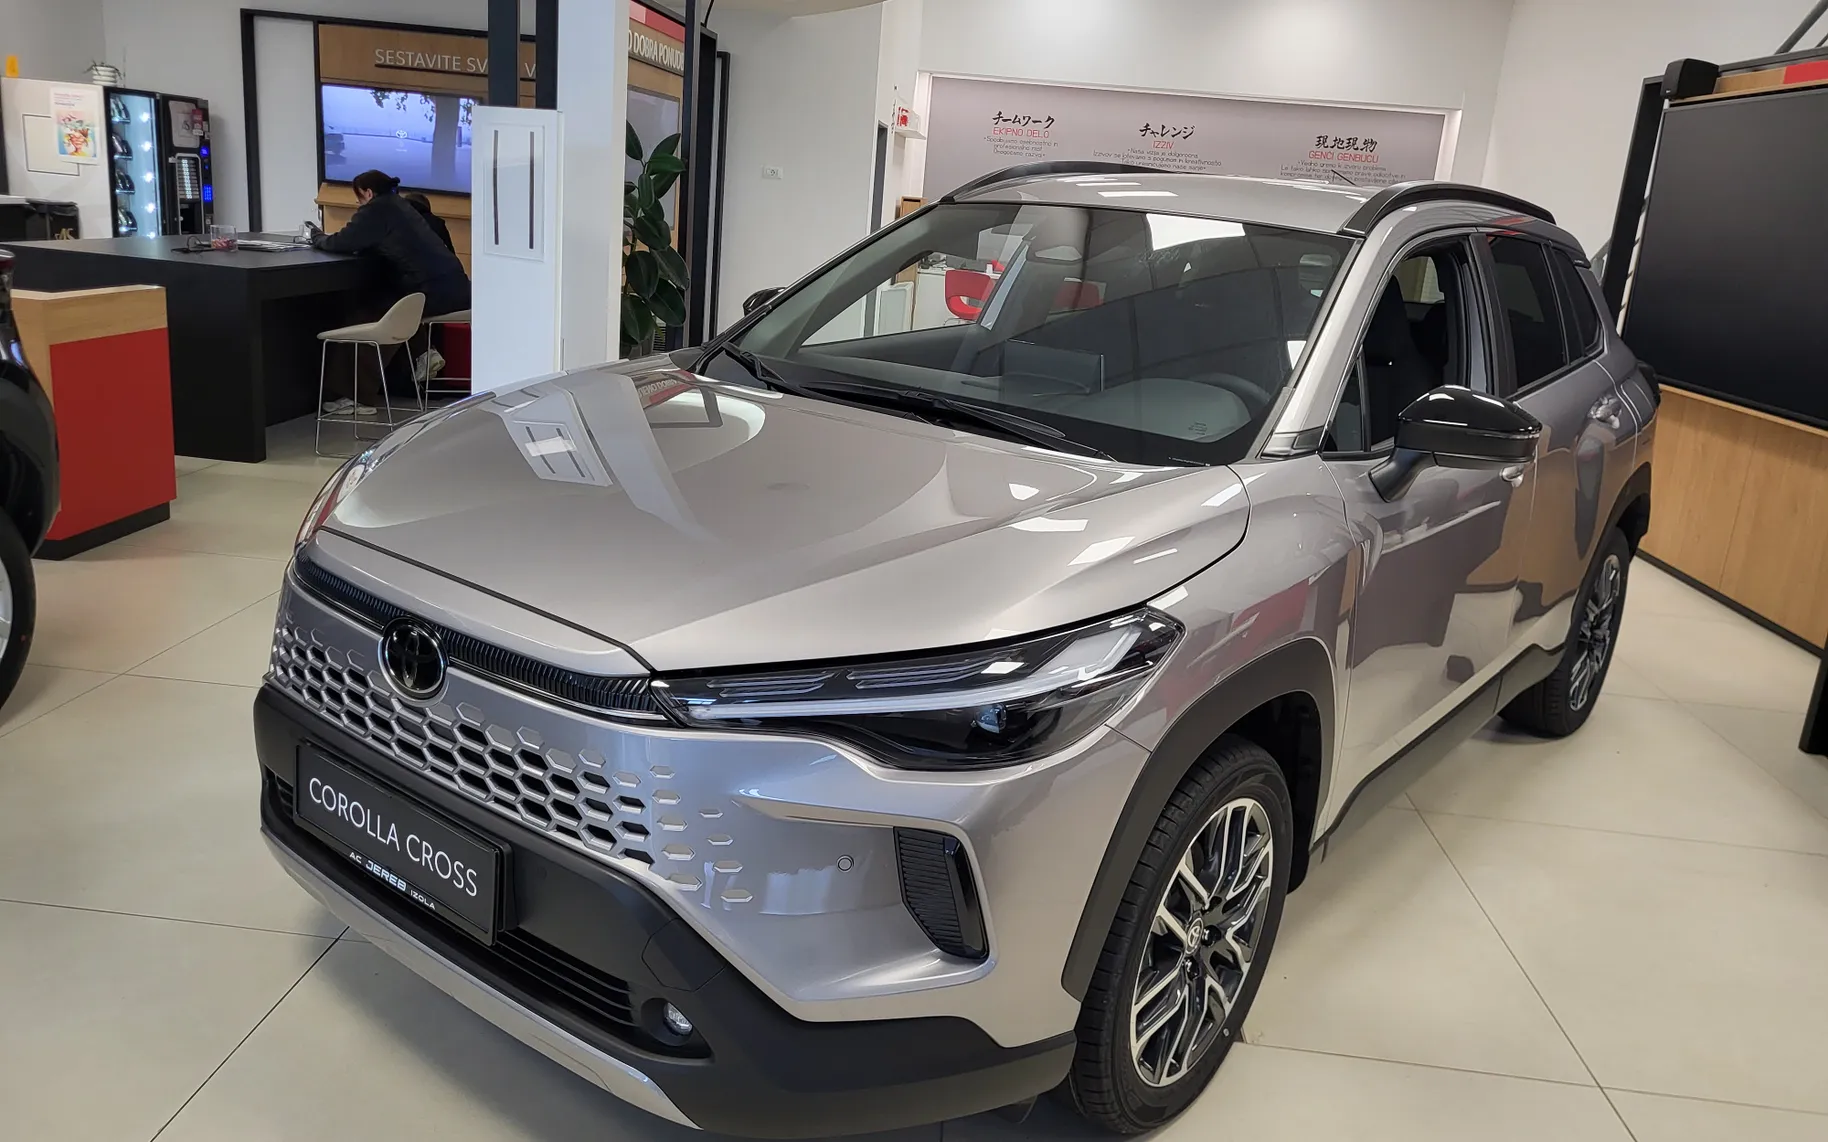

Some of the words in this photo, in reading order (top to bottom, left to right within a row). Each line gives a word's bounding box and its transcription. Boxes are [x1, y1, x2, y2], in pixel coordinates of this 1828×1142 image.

[375, 48, 461, 72] SESTAVITE
[633, 32, 658, 62] DOBRA
[659, 43, 685, 71] PONUDB
[992, 110, 1055, 129] チームワーク
[993, 127, 1024, 137] EKIPNO
[1026, 129, 1050, 139] DELO
[1139, 122, 1196, 140] チャレンジ
[1152, 140, 1175, 150] IZZIV
[1315, 135, 1378, 153] 現地現物
[309, 777, 401, 852] COROLLA
[406, 834, 477, 897] CROSS
[349, 851, 362, 864] AC
[365, 860, 407, 892] JEREB
[410, 889, 436, 911] IZOLA
